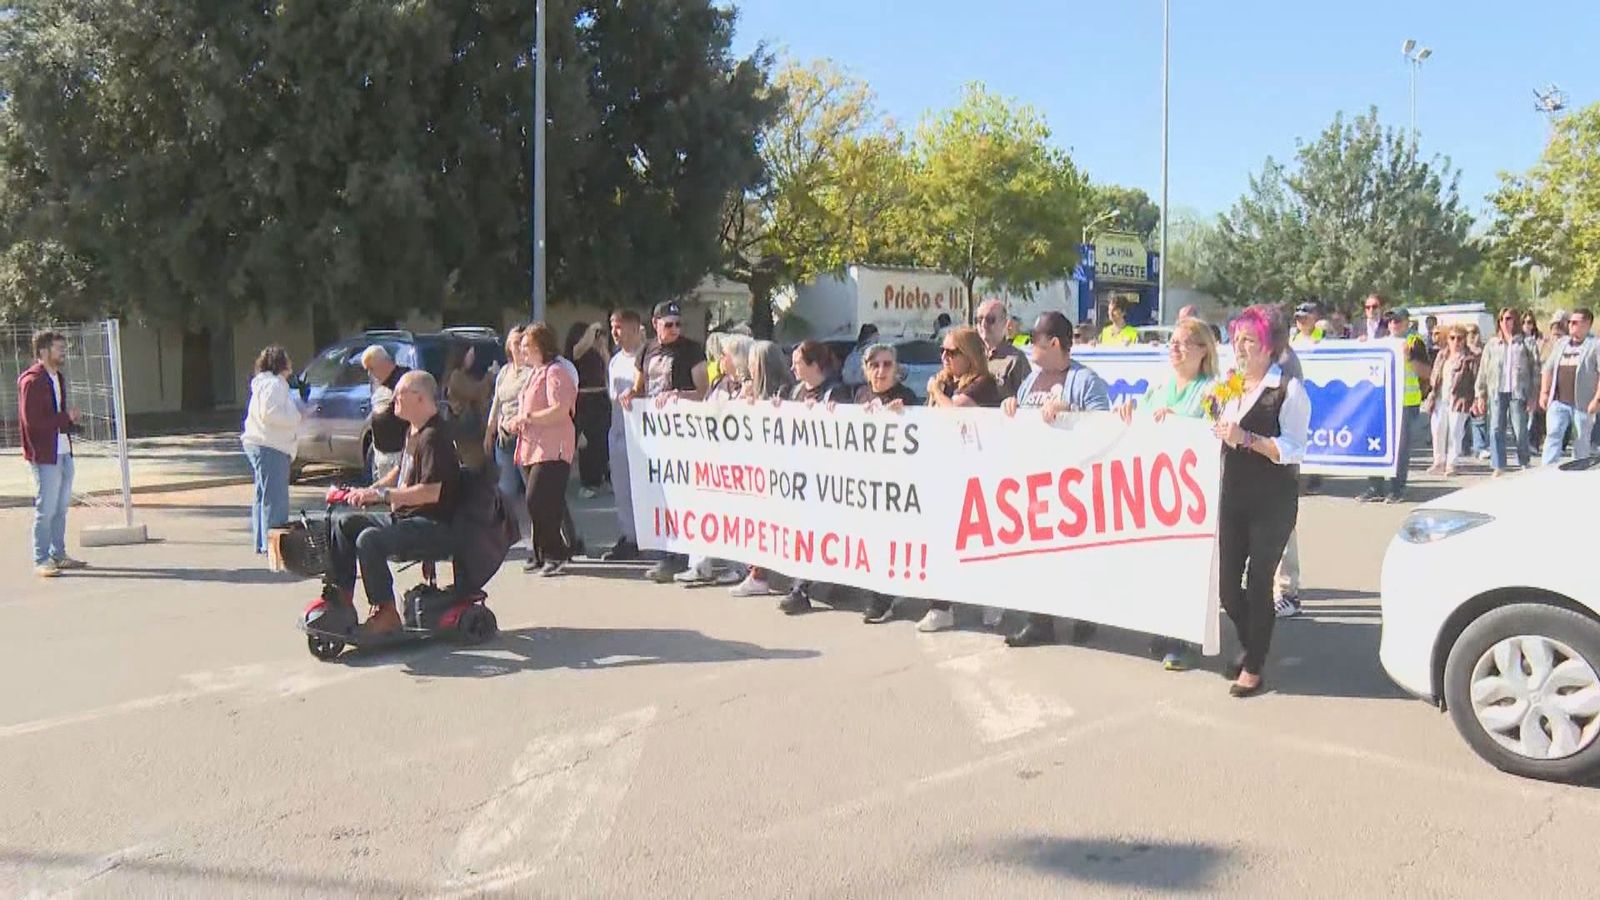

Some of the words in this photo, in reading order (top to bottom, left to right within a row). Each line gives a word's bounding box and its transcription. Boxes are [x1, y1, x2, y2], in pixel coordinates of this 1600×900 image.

[642, 411, 753, 442] NUESTROS
[762, 416, 920, 455] FAMILIARES
[648, 457, 690, 486] HAN
[694, 459, 766, 494] MUERTO
[769, 468, 808, 501] POR
[815, 472, 922, 515] VUESTRA
[955, 448, 1207, 551] ASESINOS
[654, 507, 871, 573] INCOMPETENCIA
[888, 540, 928, 581] !!!
